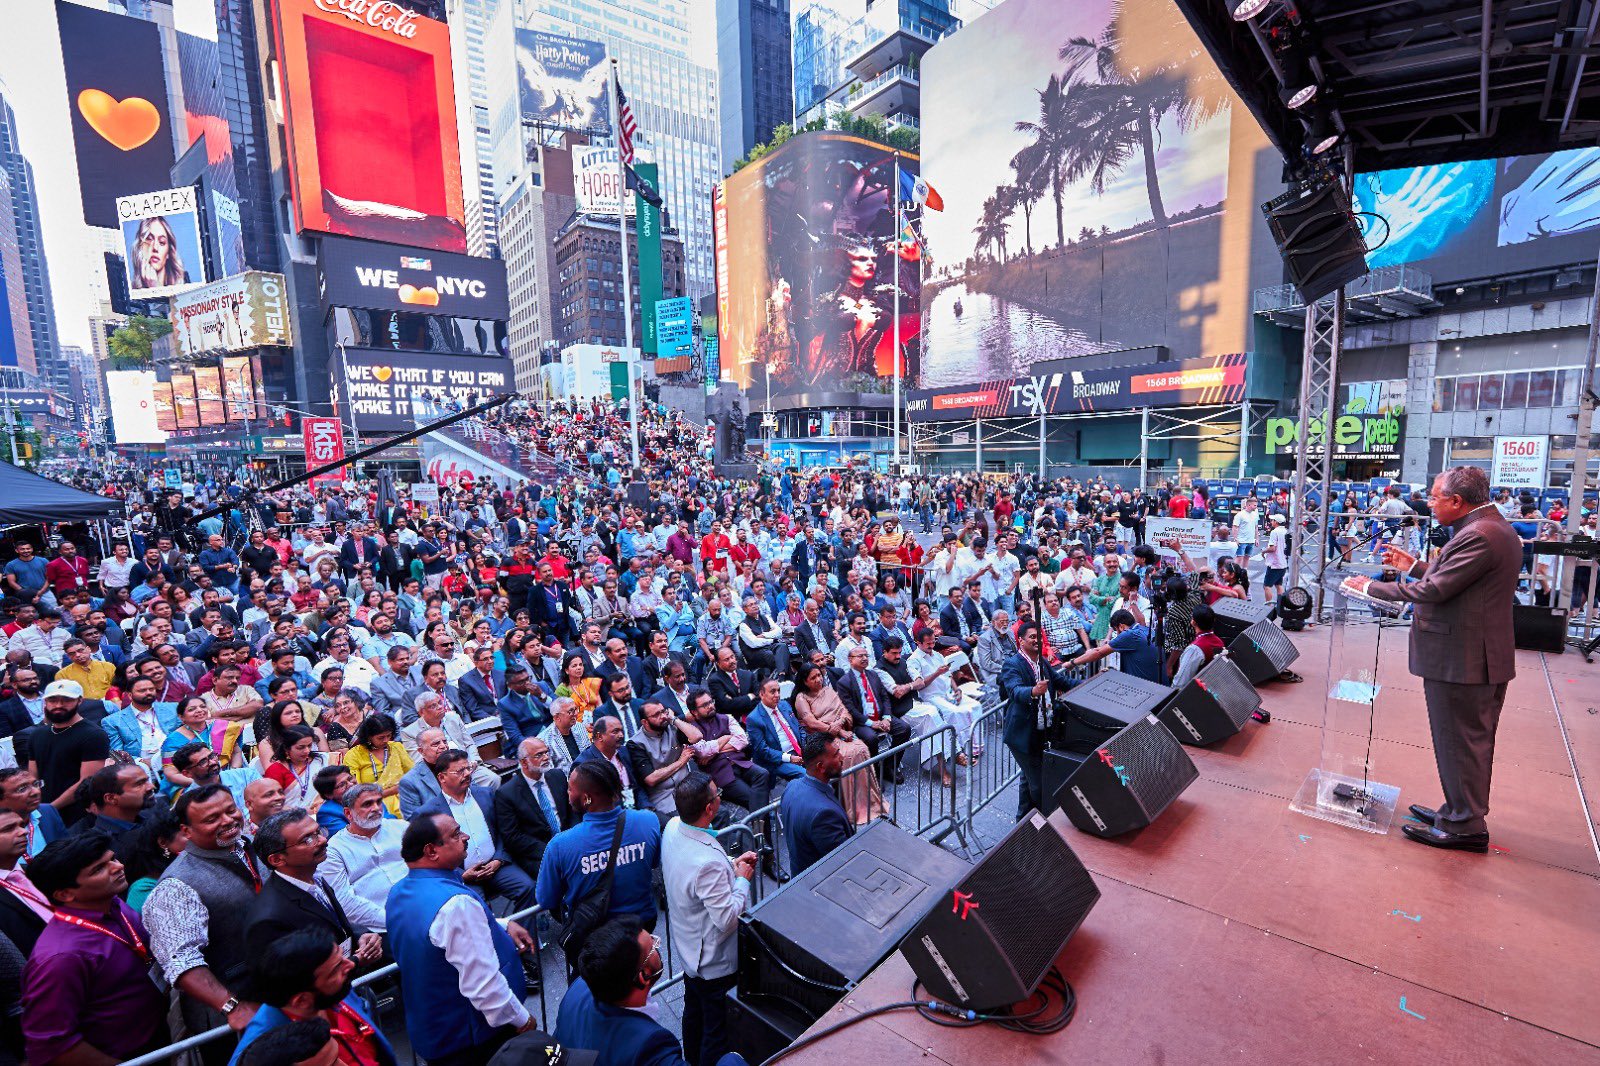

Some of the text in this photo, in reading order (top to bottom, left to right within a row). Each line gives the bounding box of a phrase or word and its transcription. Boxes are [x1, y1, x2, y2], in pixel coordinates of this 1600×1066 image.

[534, 44, 591, 67] Harry Potter
[581, 150, 619, 169] LITTLE
[119, 190, 192, 218] OLAPLEX
[642, 199, 652, 237] hatsApp
[355, 265, 488, 298] WE NYC
[179, 289, 245, 320] MISSIONARY STYLE
[347, 365, 505, 387] WE THAT IF YOU CAN
[1145, 372, 1227, 389] 1568 BROADWAY
[350, 383, 391, 399] MAKE
[393, 384, 408, 399] IT
[953, 394, 988, 404] BROADWAY
[1009, 375, 1047, 417] TSX
[1072, 379, 1121, 399] BROADWAY
[352, 399, 393, 415] MAKE
[395, 400, 409, 415] IT
[312, 421, 337, 460] tkts
[1284, 444, 1347, 454] SCCR
[1502, 441, 1536, 456] 1560
